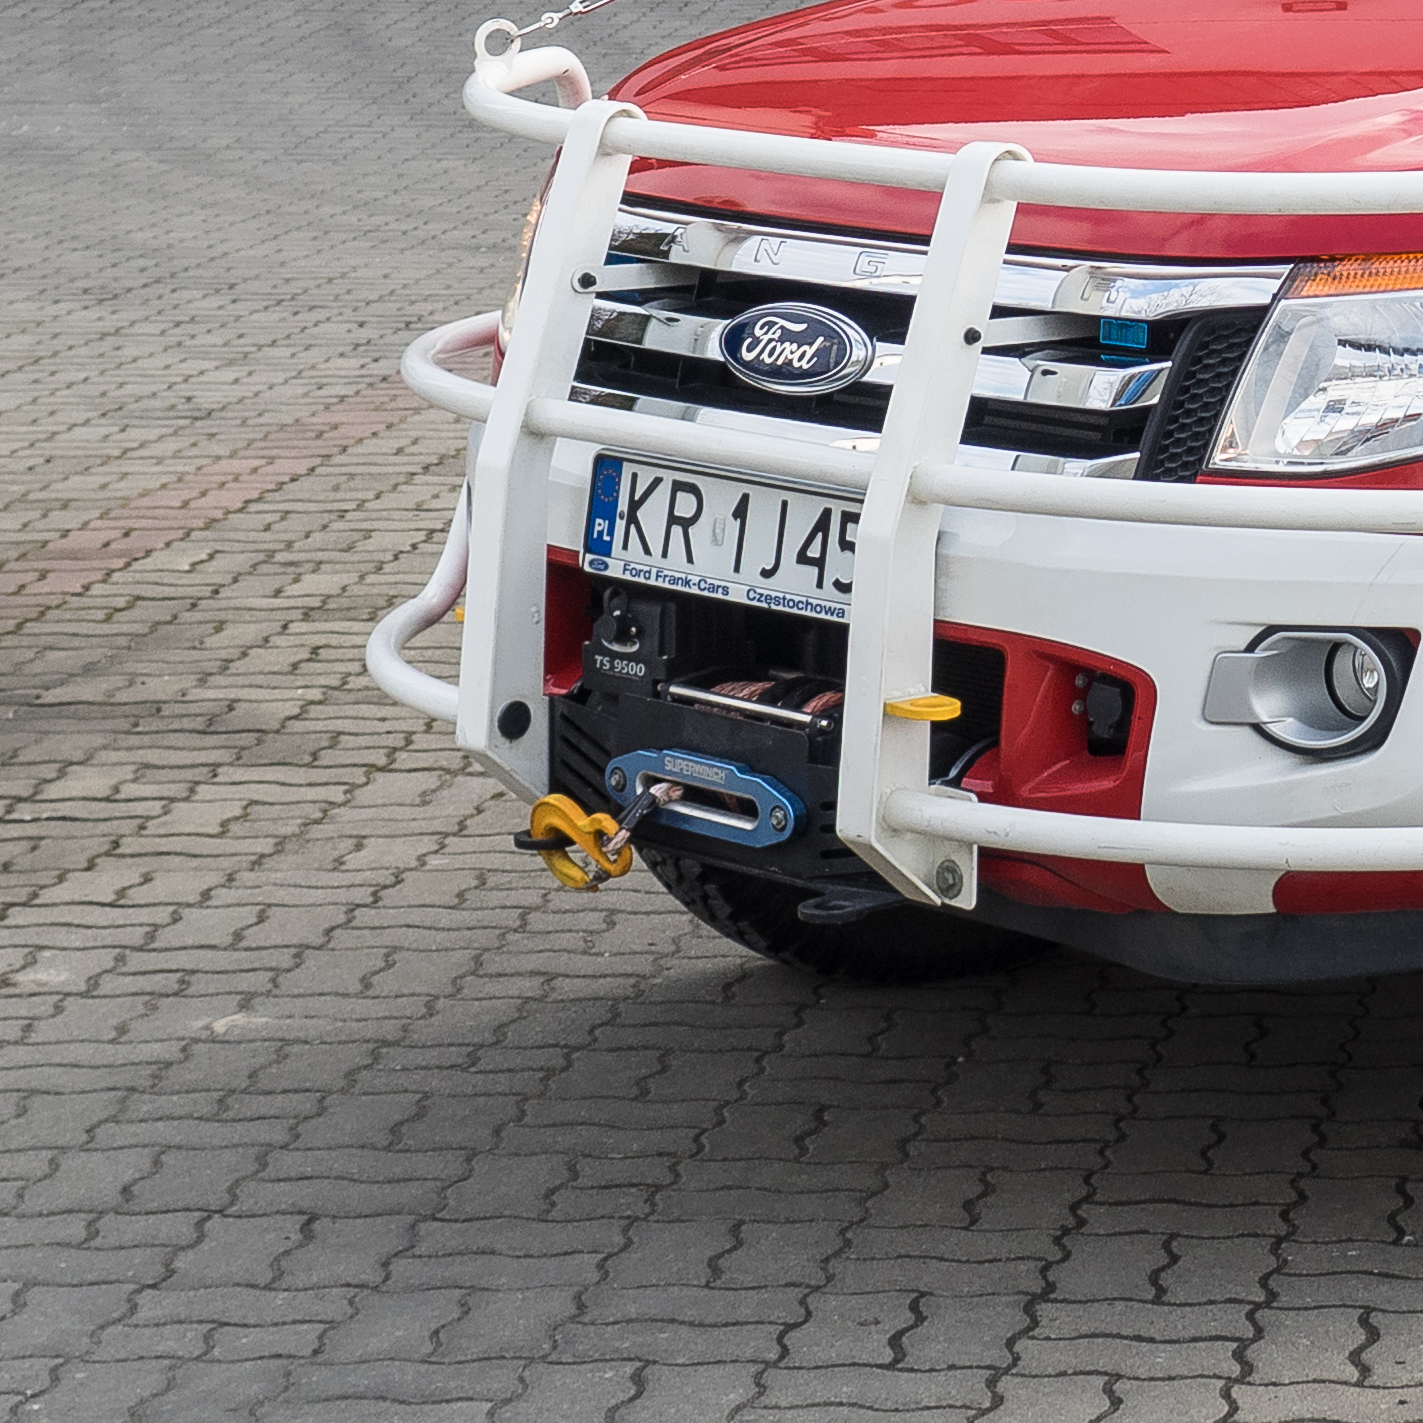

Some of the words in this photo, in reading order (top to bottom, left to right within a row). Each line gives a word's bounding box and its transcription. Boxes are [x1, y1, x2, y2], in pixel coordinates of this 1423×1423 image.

[660, 225, 1127, 304] ANGR
[740, 315, 826, 371] Ford
[593, 517, 611, 542] PL
[621, 471, 705, 566] KR
[621, 562, 651, 581] Ford
[655, 570, 730, 597] Frank-Cars
[745, 587, 847, 620] Częstochowa
[594, 654, 611, 670] TS
[613, 658, 646, 677] 9500
[664, 756, 727, 784] SUPERWINCH
